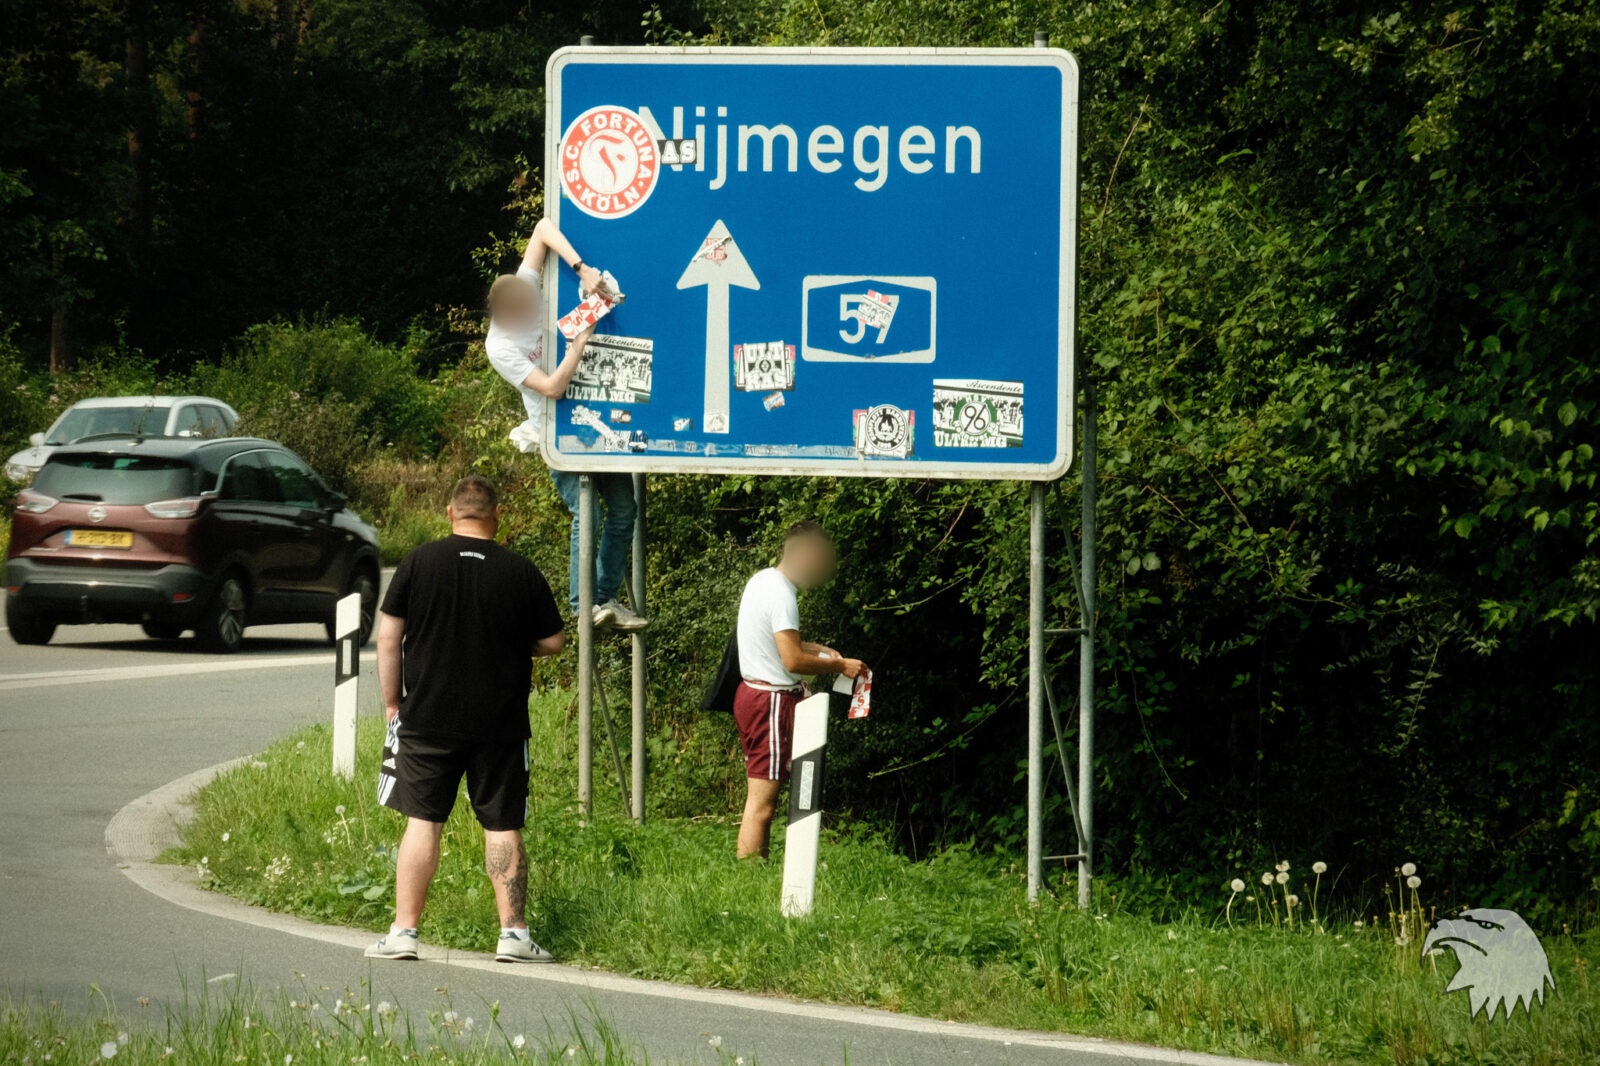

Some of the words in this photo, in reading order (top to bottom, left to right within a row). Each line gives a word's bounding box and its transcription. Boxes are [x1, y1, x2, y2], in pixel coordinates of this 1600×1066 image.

[580, 112, 654, 180] FORTUNA
[638, 106, 981, 192] Nijmegen
[579, 186, 640, 212] KÖLN
[839, 293, 900, 344] 57
[565, 384, 607, 401] ULTRA
[965, 380, 1022, 393] Ascendente
[964, 404, 986, 432] 96
